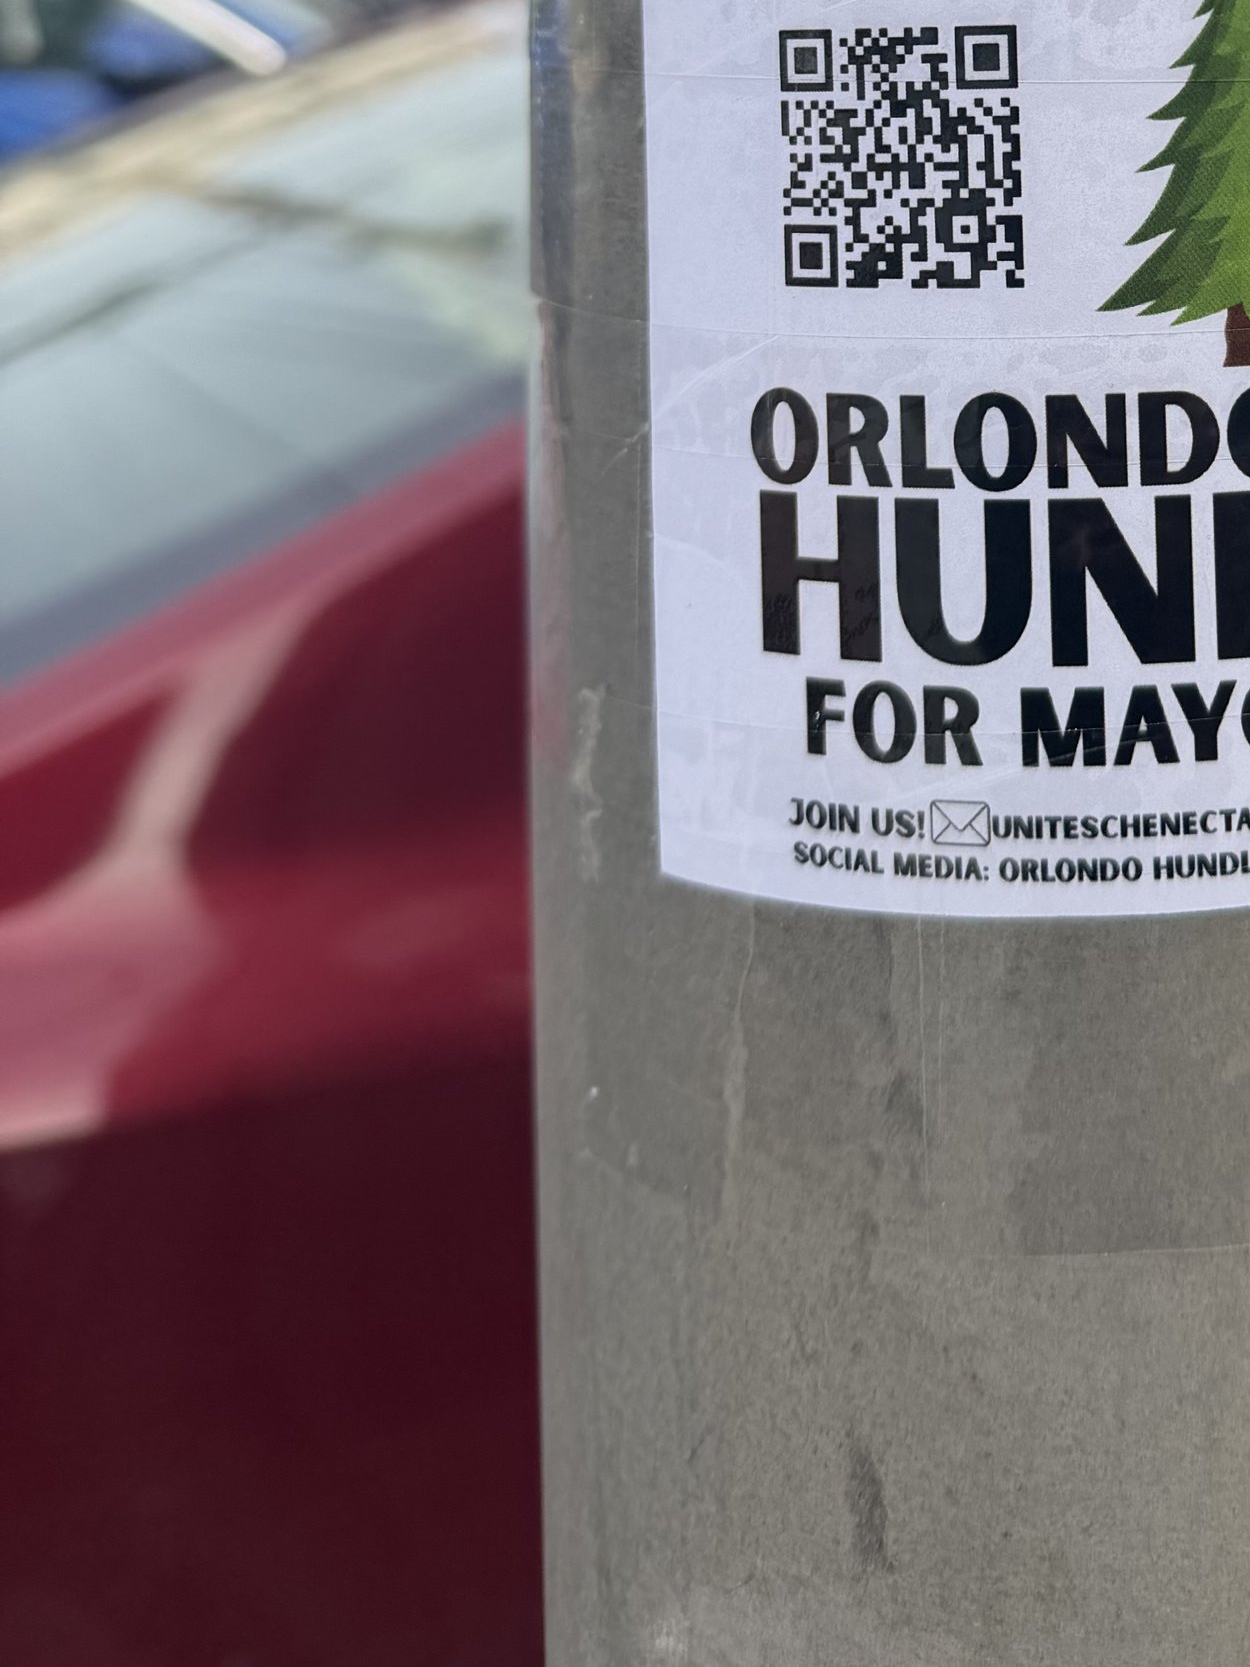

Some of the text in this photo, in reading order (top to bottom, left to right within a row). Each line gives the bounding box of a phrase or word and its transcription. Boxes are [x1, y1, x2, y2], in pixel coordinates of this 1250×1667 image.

[806, 676, 983, 766] FOR
[789, 797, 860, 834] JOIN
[871, 807, 925, 839] US!
[793, 841, 884, 874] SOCIAL
[893, 852, 989, 881] MEDIA:
[999, 856, 1142, 882] ORLONDO
